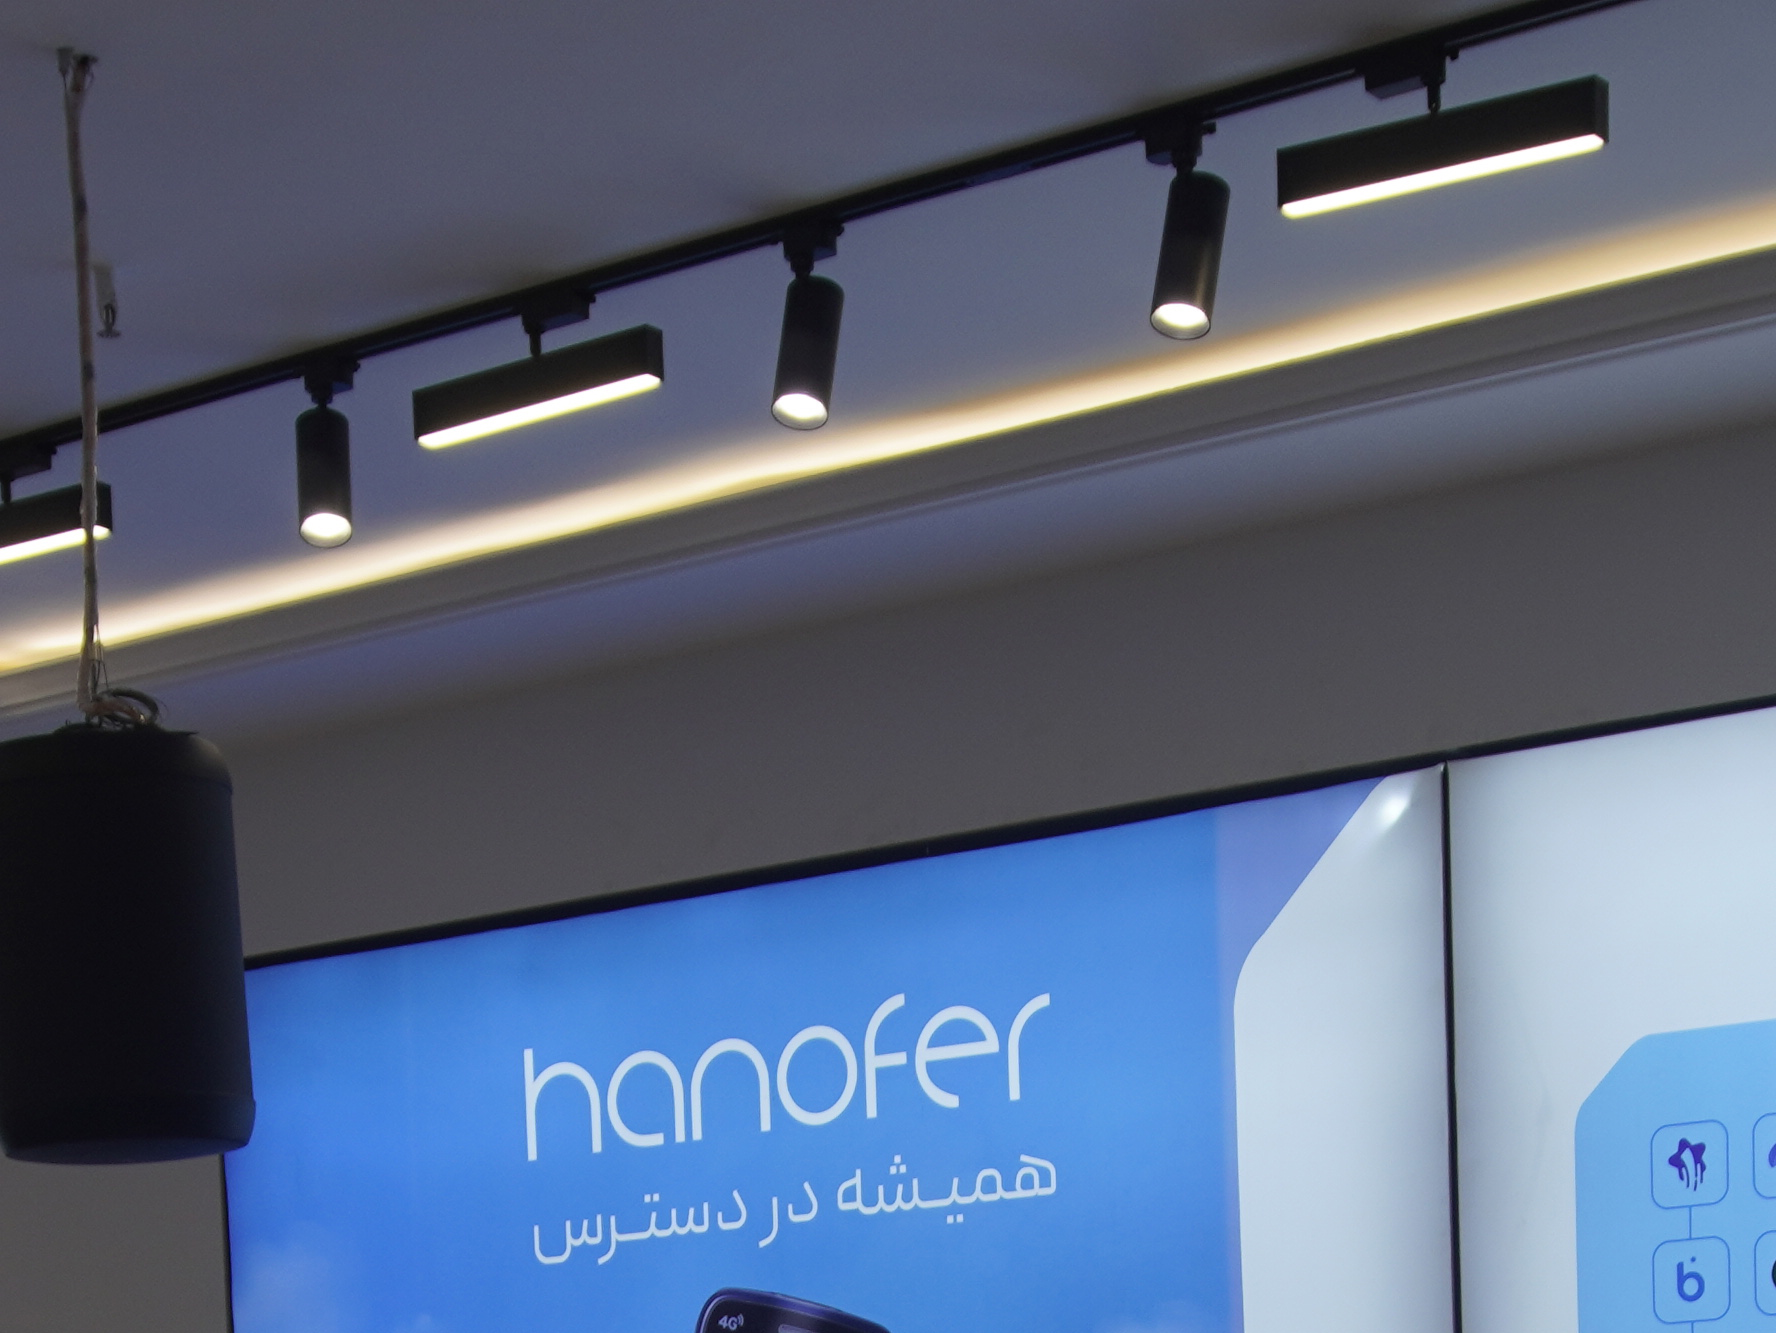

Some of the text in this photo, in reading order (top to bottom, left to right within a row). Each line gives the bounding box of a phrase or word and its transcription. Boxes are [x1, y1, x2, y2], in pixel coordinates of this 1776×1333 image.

[523, 992, 1052, 1162] hanofer
[532, 1153, 1059, 1267] همیشه در دسترس
